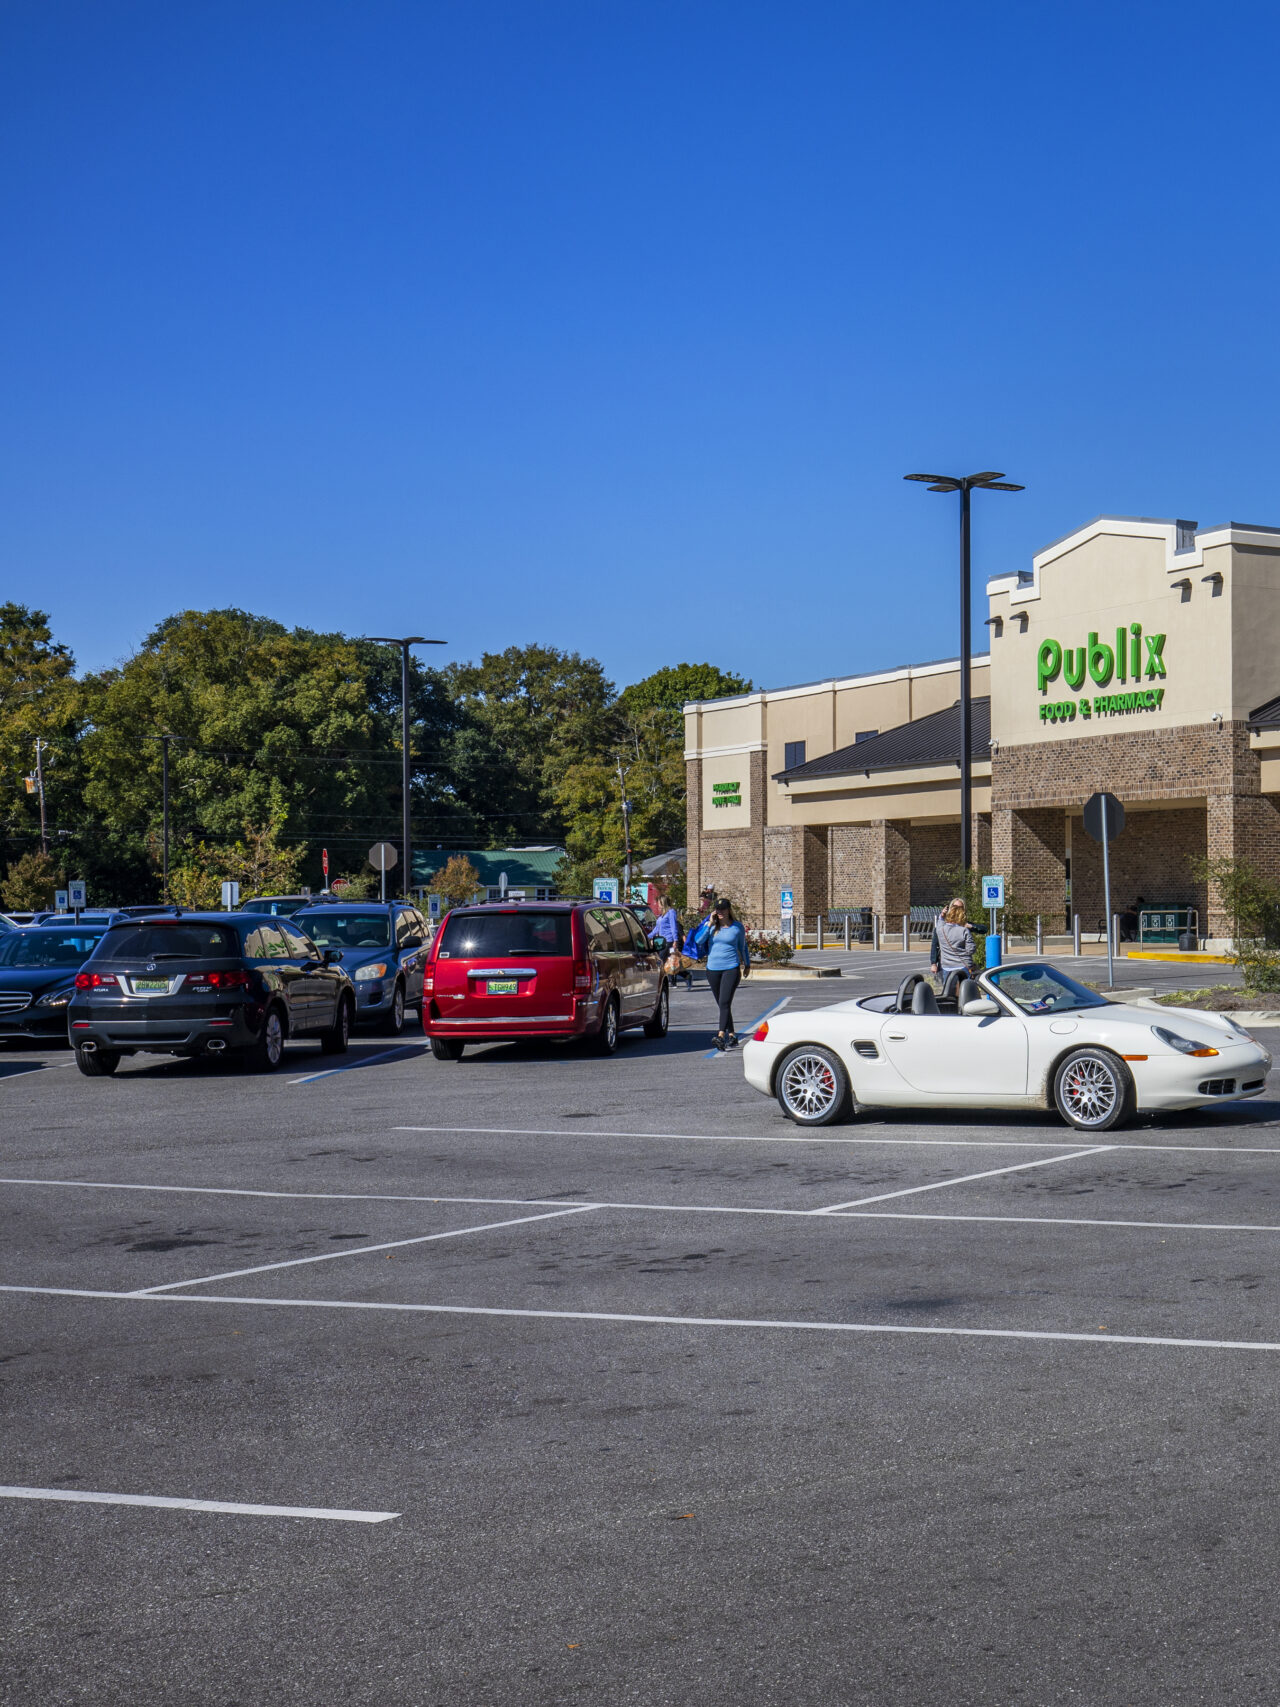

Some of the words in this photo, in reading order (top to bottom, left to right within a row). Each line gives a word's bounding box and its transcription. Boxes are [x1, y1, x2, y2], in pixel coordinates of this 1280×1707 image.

[1037, 622, 1167, 691] Publix
[1039, 701, 1076, 720] FOOD
[1078, 698, 1092, 715] &
[1093, 688, 1165, 713] PHARMACY
[333, 883, 348, 891] STOP
